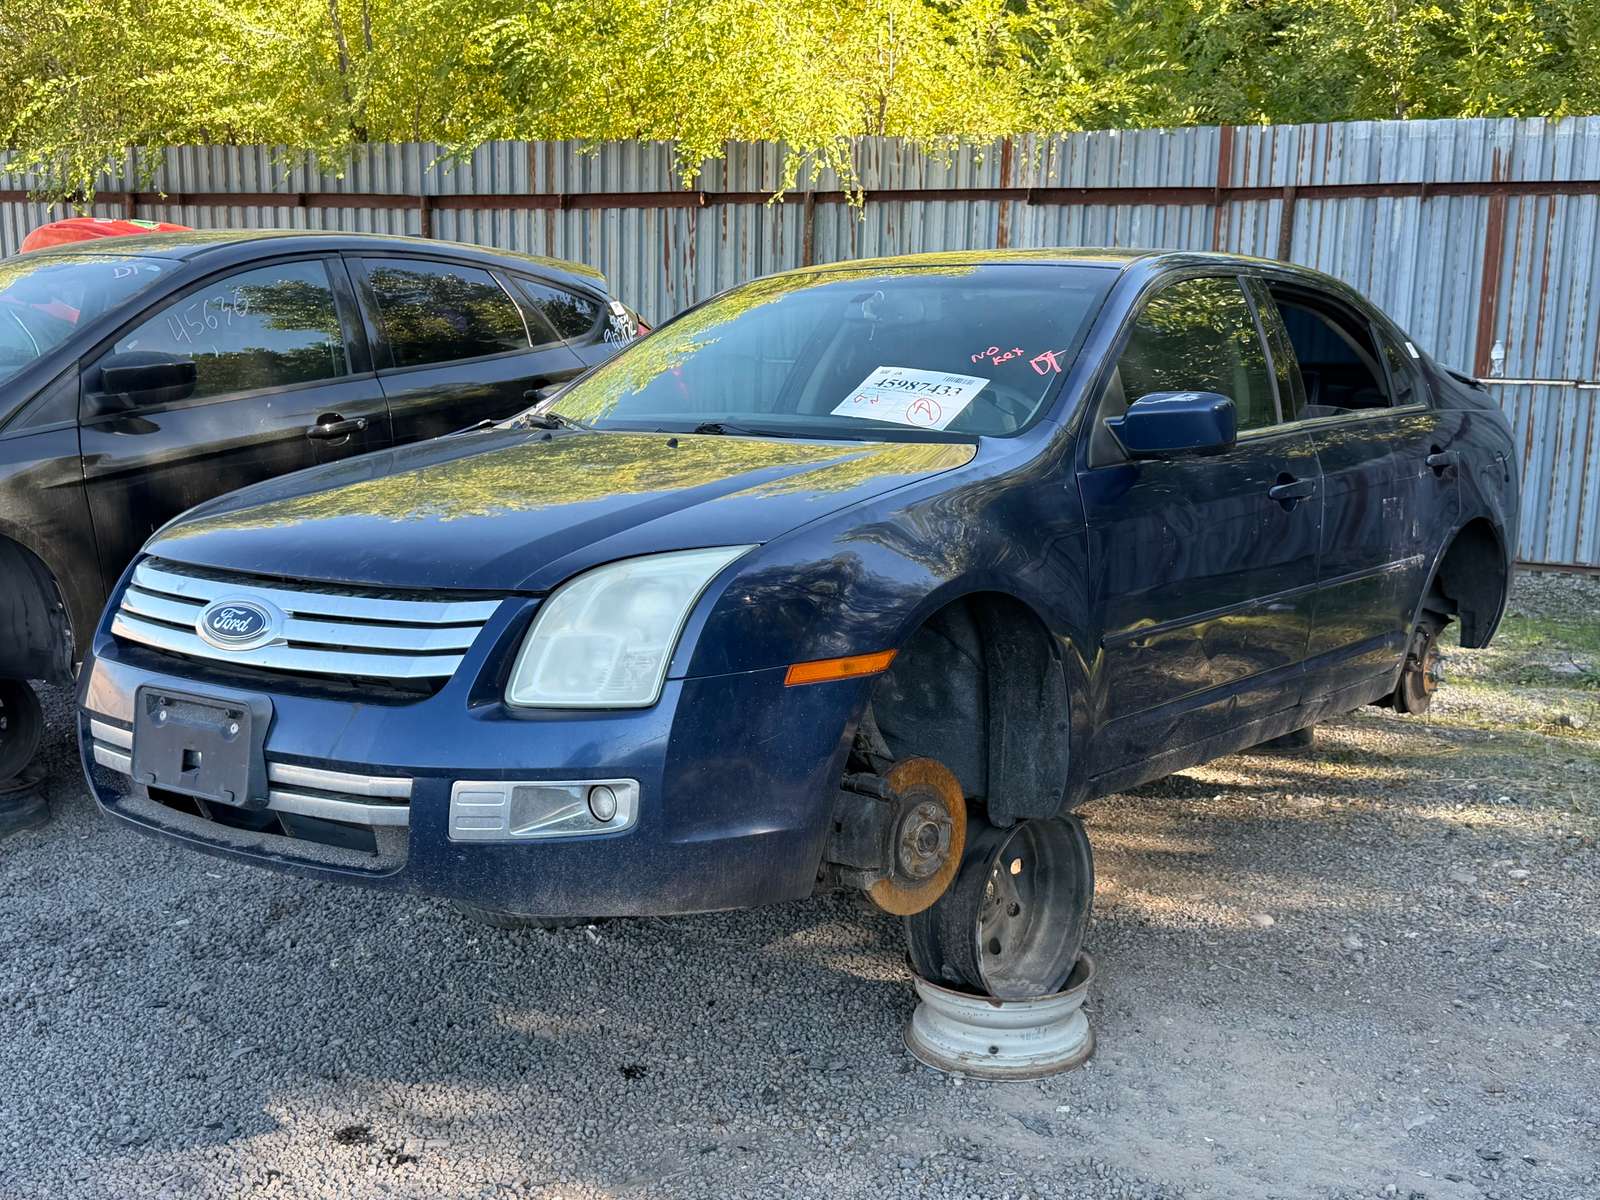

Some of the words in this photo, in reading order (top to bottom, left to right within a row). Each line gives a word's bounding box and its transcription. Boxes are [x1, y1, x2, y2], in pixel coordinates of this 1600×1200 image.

[874, 378, 963, 397] 45987433
[913, 399, 934, 421] A
[213, 608, 253, 632] Ford
